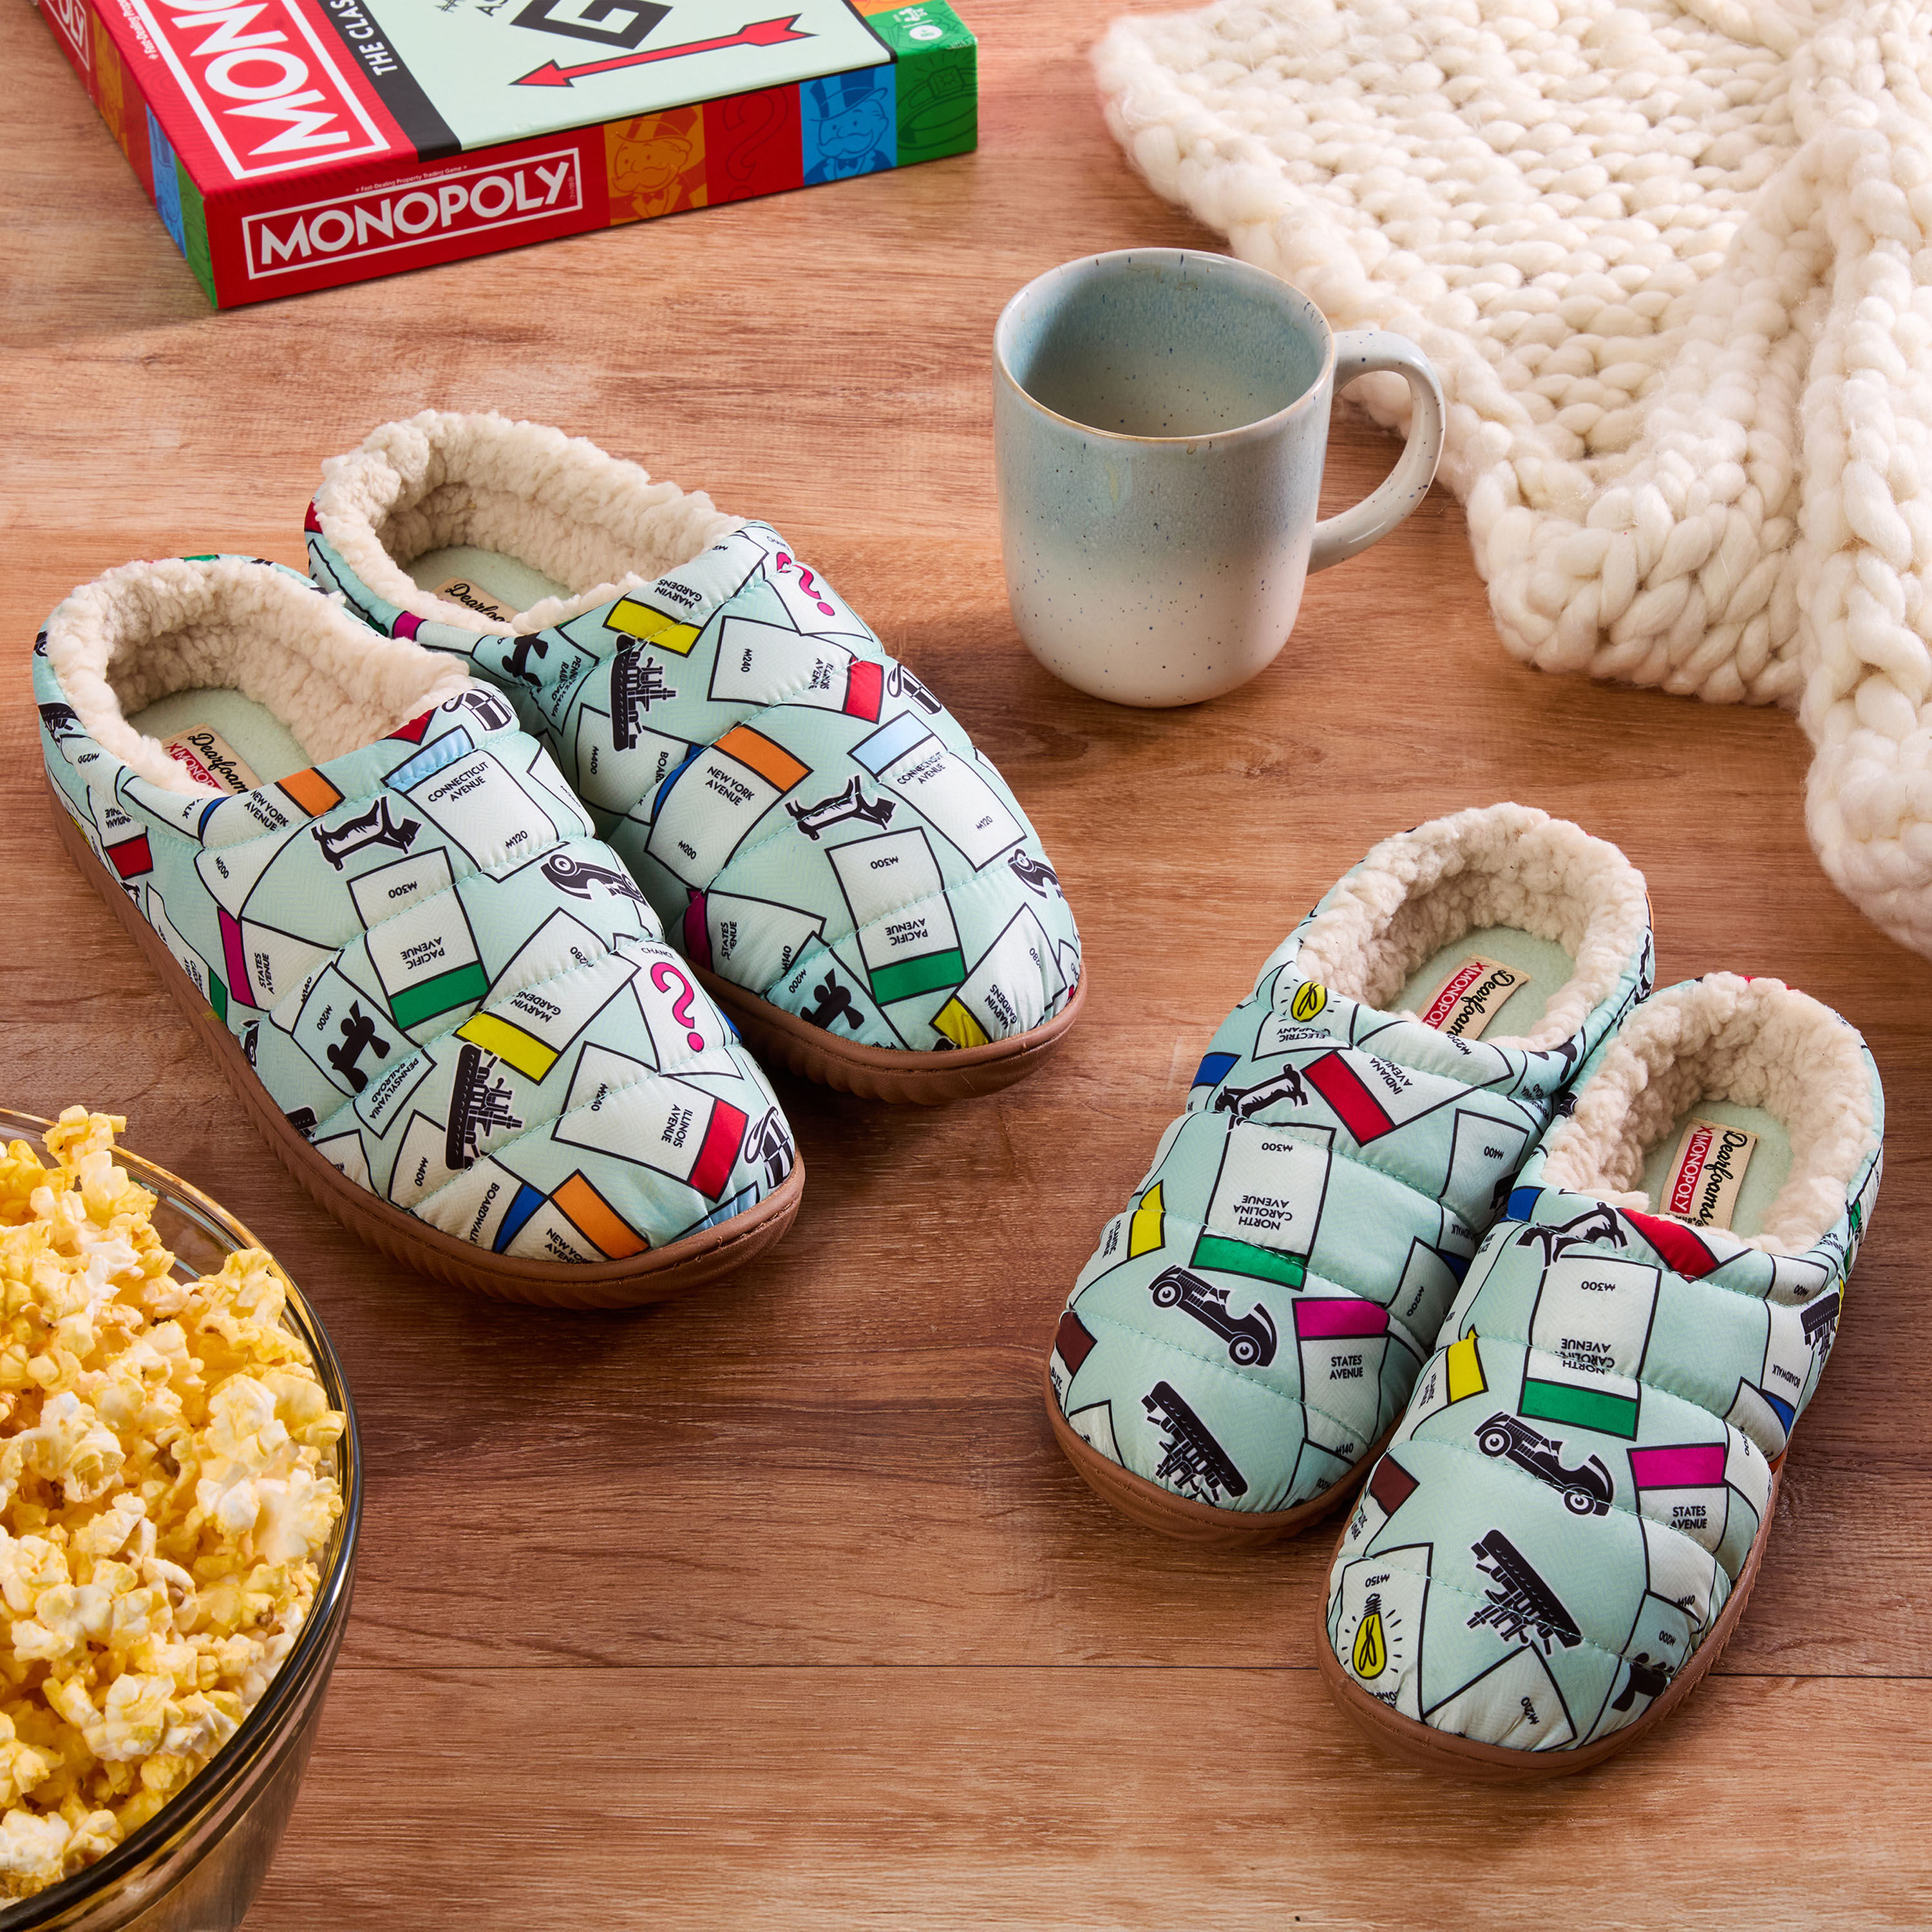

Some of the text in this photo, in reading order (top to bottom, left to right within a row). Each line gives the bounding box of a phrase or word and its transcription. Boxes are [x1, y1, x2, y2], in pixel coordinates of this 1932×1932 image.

[359, 41, 398, 76] THE
[361, 180, 396, 192] Fast-Dealing
[396, 174, 422, 184] Property
[423, 169, 444, 179] Trading
[261, 161, 569, 265] MONOPOLY
[654, 587, 695, 609] MARVIN
[658, 579, 702, 601] GARDENS
[187, 733, 249, 794] Dearfoam
[917, 763, 946, 784] AVENUE
[428, 761, 489, 803] CONNECTICUT
[450, 776, 486, 802] AVENUE
[705, 779, 743, 806] AVENUE
[706, 766, 755, 800] NEW YORK
[244, 801, 278, 831] AVENUE
[250, 790, 289, 828] NEW YORK
[886, 918, 926, 935] AVENUE
[890, 929, 928, 946] PACIFIC
[400, 936, 442, 960] AVENUE
[721, 922, 729, 958] STATES
[406, 947, 446, 970] PACIFIC
[641, 947, 675, 961] CHANCE
[254, 952, 267, 988] STATES
[263, 952, 275, 994] AVENUE
[517, 990, 562, 1015] GARDENS
[989, 983, 1017, 1025] GARDENS
[1424, 968, 1477, 1027] MONOPOL
[1446, 970, 1515, 1036] Dearfoam
[511, 998, 553, 1023] MARVIN
[985, 996, 1009, 1030] MARVIN
[1278, 1030, 1327, 1043] ELECTRIC
[370, 1057, 419, 1119] PENNSYLVANIA
[371, 1063, 406, 1103] RAILROAD
[1369, 1057, 1402, 1095] INDIANA
[661, 1104, 679, 1143] AVENUE
[672, 1108, 694, 1149] ILLINOIS
[1674, 1135, 1709, 1211] MONOPOLY
[471, 1182, 500, 1244] BOARDWALK
[1233, 1205, 1293, 1221] CAROLINA
[1242, 1195, 1289, 1208] AVENUE
[1238, 1216, 1281, 1231] NORTH
[546, 1227, 570, 1250] NEW
[1560, 1338, 1611, 1353] AVENUE
[1329, 1367, 1364, 1379] AVENUE
[1331, 1354, 1363, 1367] STATES
[1562, 1359, 1605, 1375] NORTH
[1772, 1363, 1801, 1388] BOARDWALK
[1672, 1505, 1706, 1517] STATES
[1671, 1518, 1708, 1530] AVENUE
